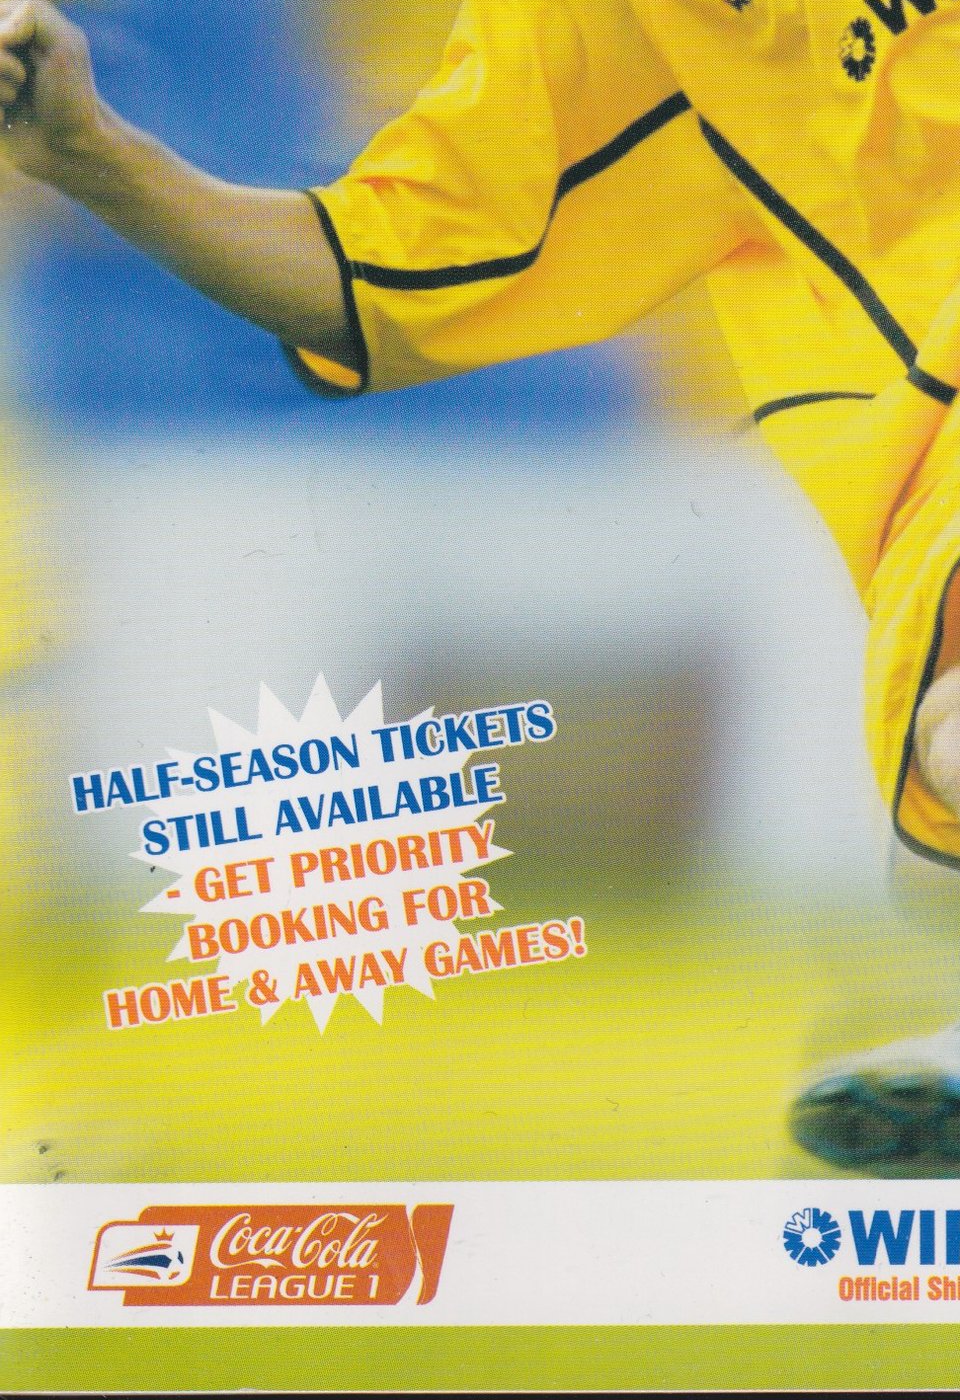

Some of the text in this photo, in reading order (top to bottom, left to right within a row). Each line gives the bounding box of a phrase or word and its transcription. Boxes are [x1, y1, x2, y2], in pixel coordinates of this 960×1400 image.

[72, 702, 555, 812] HALF-SEASON TICKETS
[141, 766, 504, 856] STILL AVAILABLE
[195, 858, 274, 903] GET
[292, 822, 495, 890] PRIORITY
[187, 880, 491, 961] BOOKING FOR
[107, 920, 586, 1028] HOME & AWAY GAMES!
[210, 1212, 388, 1269] Coca-Cola
[210, 1275, 379, 1299] LEAGUE 1
[838, 1276, 919, 1301] Official
